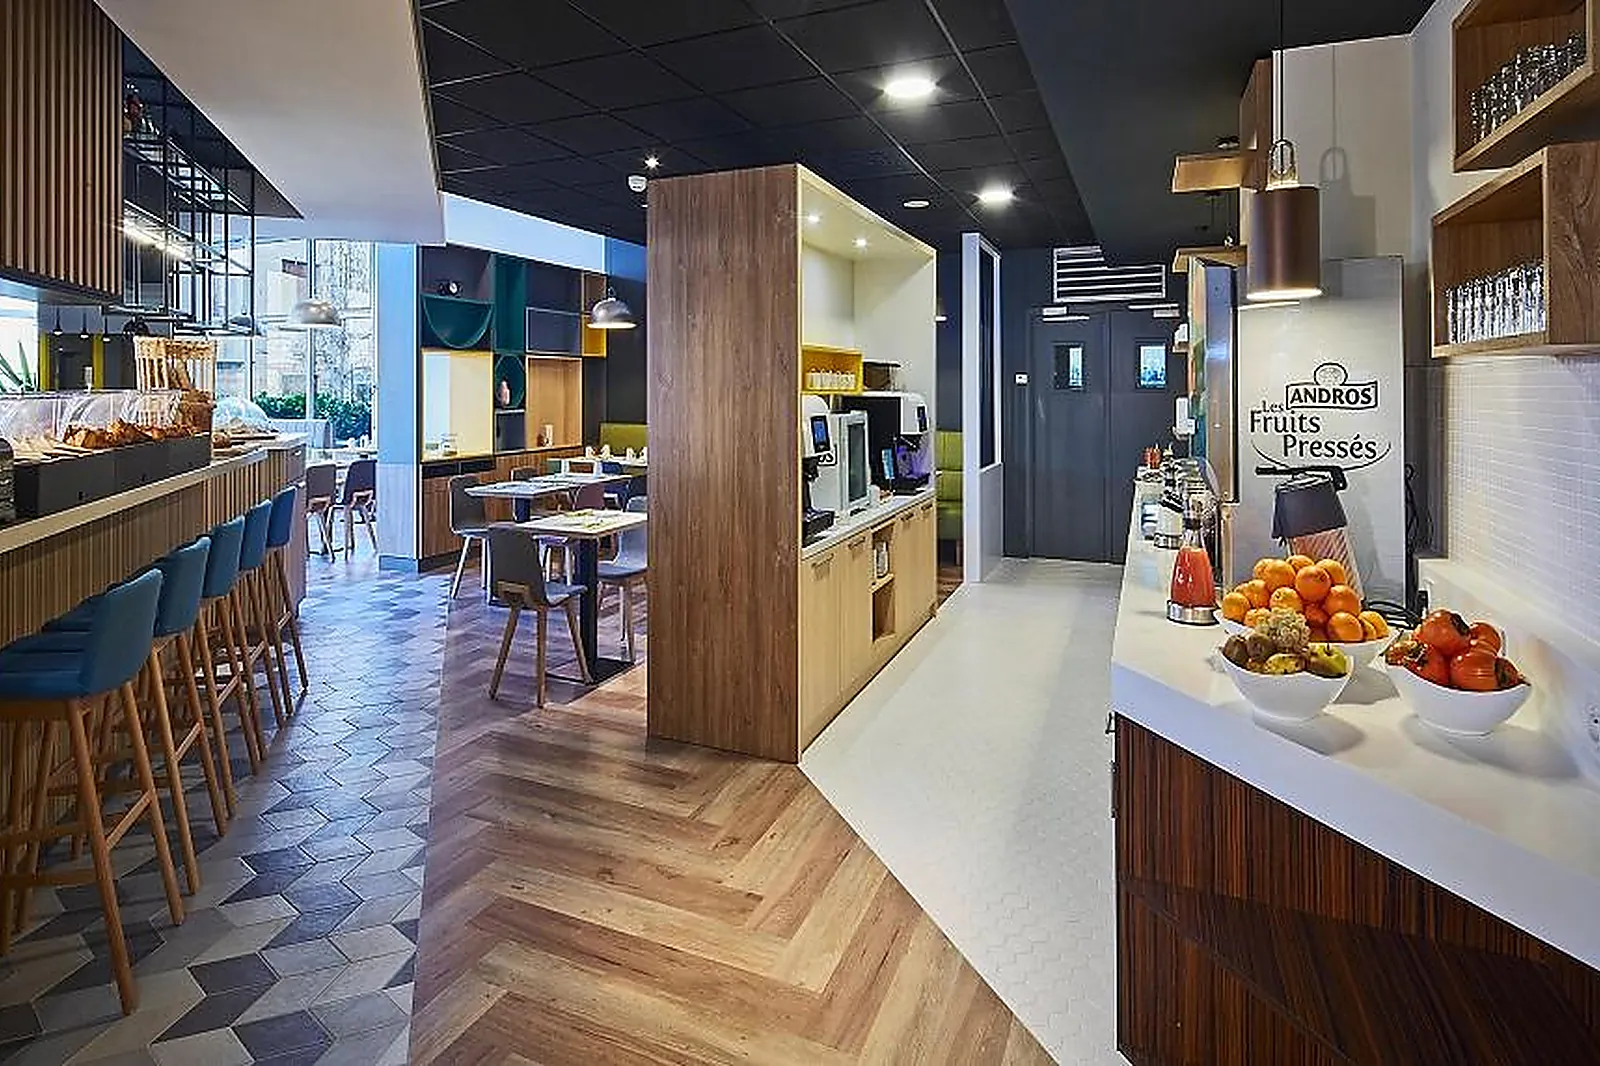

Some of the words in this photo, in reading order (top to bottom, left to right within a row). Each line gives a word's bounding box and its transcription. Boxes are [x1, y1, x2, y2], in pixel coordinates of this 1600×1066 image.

[1261, 400, 1285, 413] Les
[1289, 387, 1373, 406] ANDROS
[1250, 410, 1321, 433] Fruits
[1283, 434, 1377, 459] Pressés
